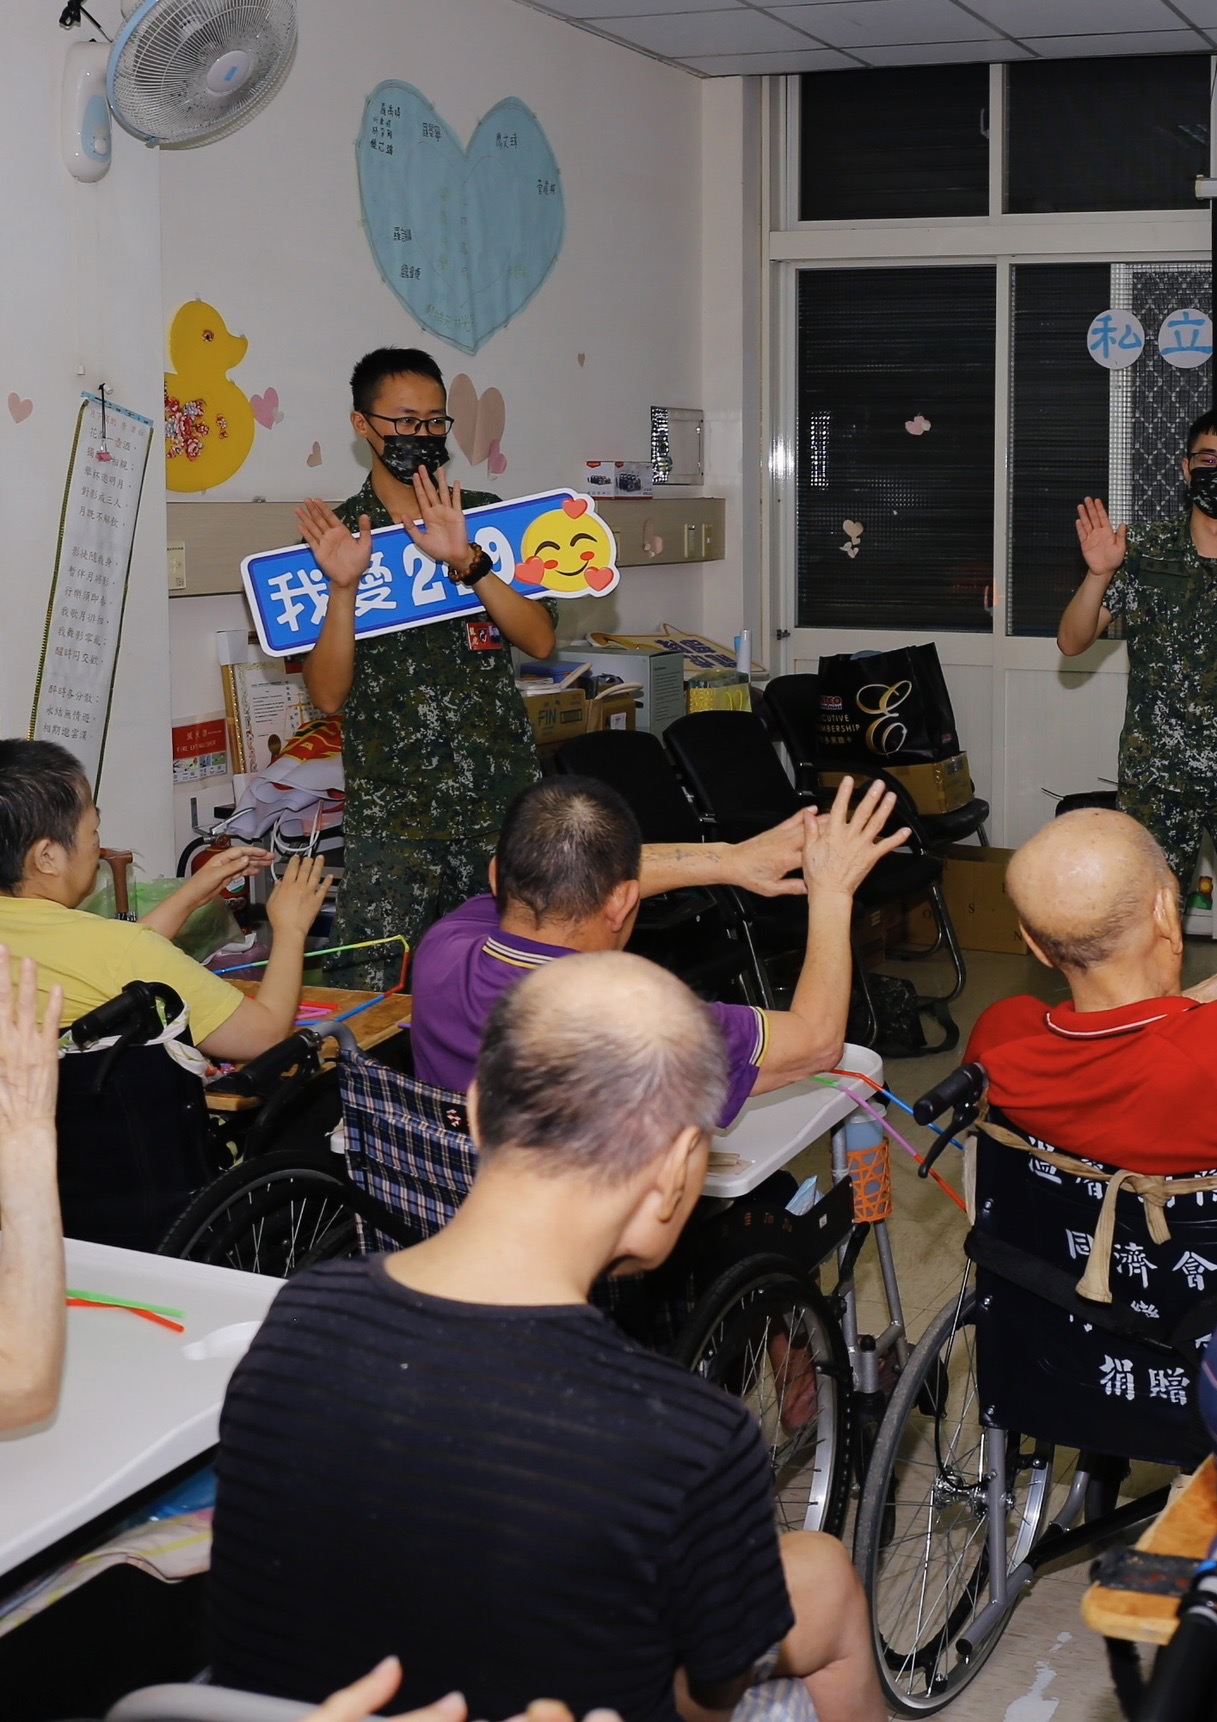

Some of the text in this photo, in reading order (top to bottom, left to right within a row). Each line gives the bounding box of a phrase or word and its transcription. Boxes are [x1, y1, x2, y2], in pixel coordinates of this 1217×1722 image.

[1090, 311, 1212, 359] 私立
[268, 526, 515, 632] 我愛29
[538, 707, 557, 726] FIN
[820, 714, 850, 722] CUTIVE
[1099, 1354, 1191, 1406] 捐贈
